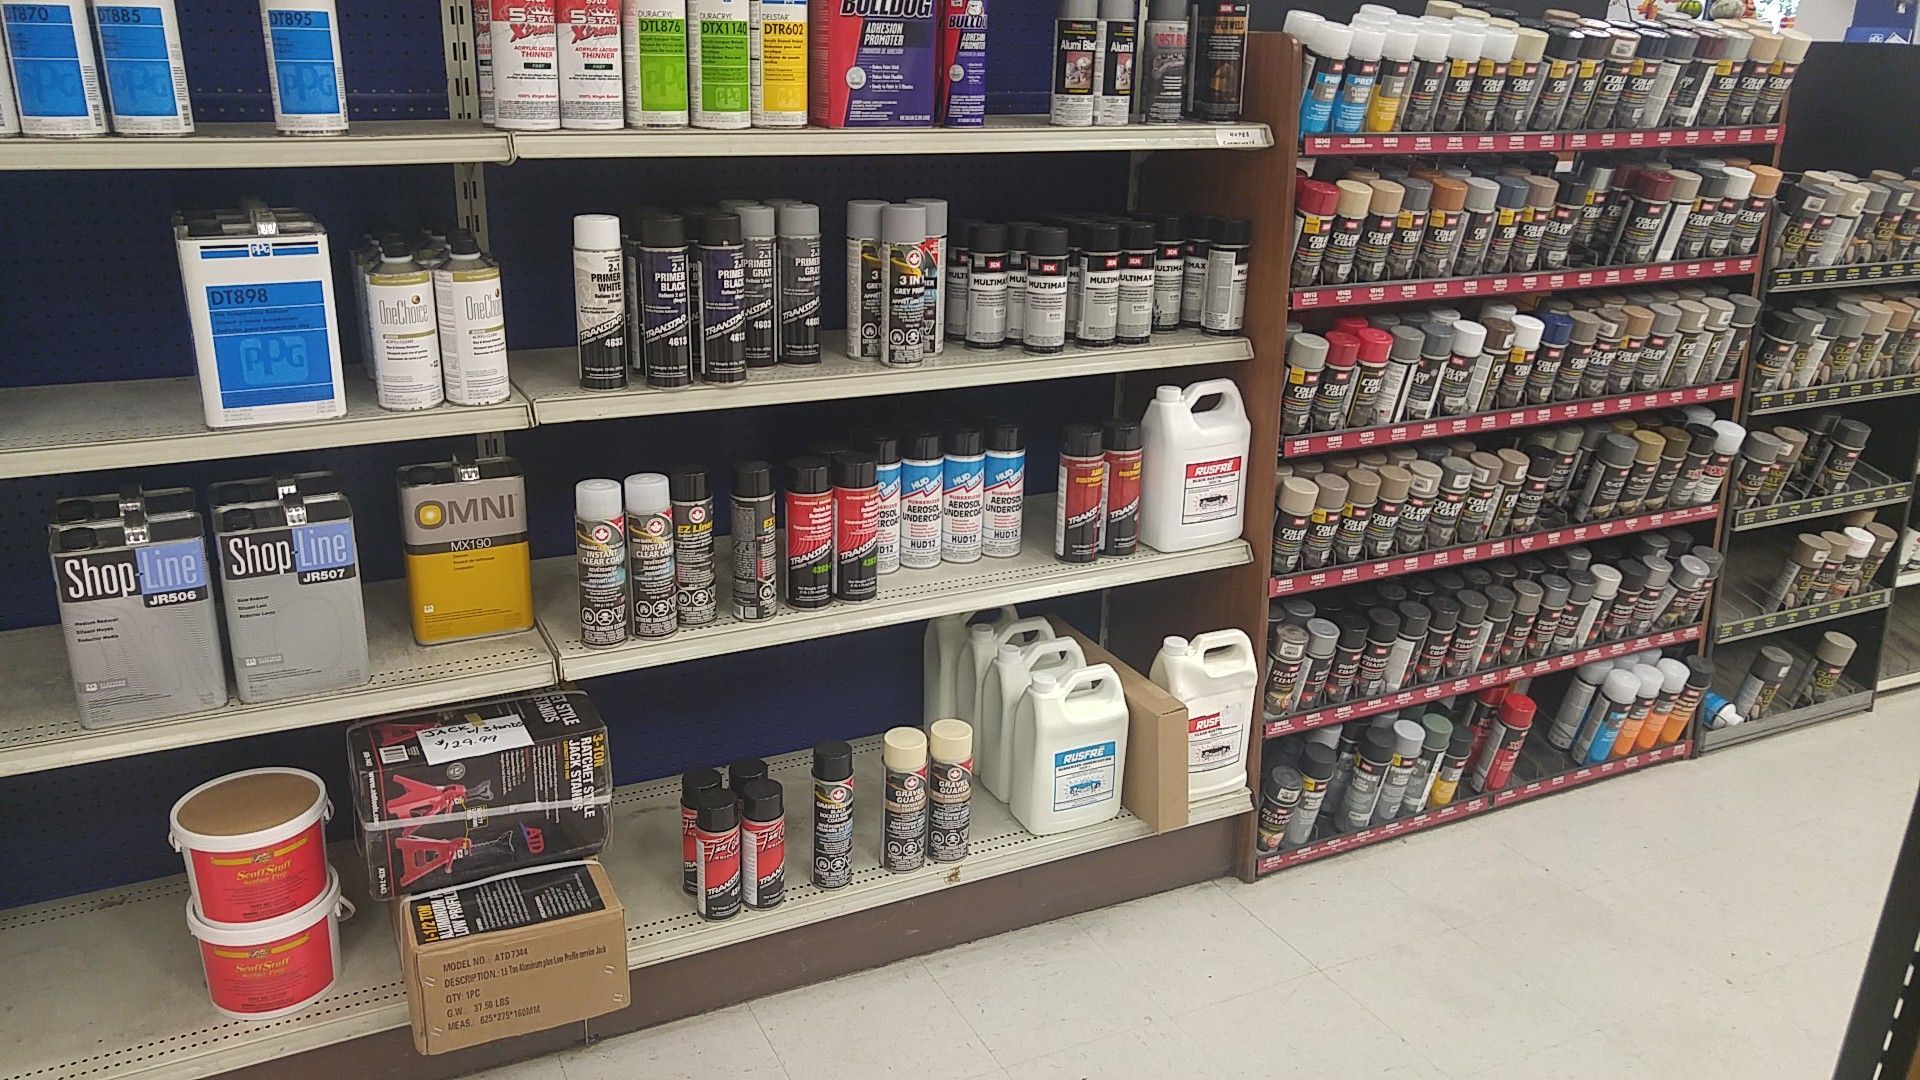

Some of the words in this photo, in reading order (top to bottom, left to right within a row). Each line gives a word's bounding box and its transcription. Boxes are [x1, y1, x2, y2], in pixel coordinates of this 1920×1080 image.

[840, 0, 932, 17] BULLDOG
[98, 8, 141, 23] DT885
[269, 13, 312, 27] DT895
[509, 8, 526, 22] 5
[570, 10, 586, 24] 5
[640, 21, 680, 32] DTL876
[702, 23, 747, 35] DTX1140
[764, 24, 803, 35] DTR602
[866, 23, 904, 34] ADHESION
[864, 34, 904, 45] PROMOTER
[1060, 39, 1081, 50] Alumi
[1110, 41, 1130, 52] Alumi
[1635, 216, 1660, 224] COLOR
[1333, 233, 1360, 241] COLOR
[1369, 238, 1390, 246] COAT
[1334, 239, 1357, 247] COAT
[251, 243, 271, 255] PPG
[744, 258, 772, 269] PRIMER
[795, 257, 821, 267] PRIMER
[654, 271, 686, 282] PRIMER
[718, 269, 744, 280] PRIMER
[752, 267, 772, 278] GRAY
[804, 267, 821, 276] GRAY
[591, 273, 621, 284] PRIMER
[899, 275, 907, 285] 3
[908, 274, 920, 285] IN
[1118, 273, 1154, 283] ULTIMAX
[598, 282, 621, 292] WHITE
[660, 281, 687, 292] BLACK
[723, 279, 745, 289] BLACK
[1028, 281, 1066, 290] MULTIMAX
[894, 287, 910, 295] GREY
[211, 289, 268, 305] DT898
[379, 300, 428, 325] OneChoice
[782, 296, 821, 321] TRANSTAR
[580, 314, 623, 340] TRANSTAR
[645, 314, 687, 339] TRANSTAR
[705, 310, 746, 335] TRANSTAR
[753, 320, 772, 329] 4603
[668, 336, 688, 347] 4613
[245, 338, 305, 375] PPG
[953, 472, 971, 485] HUD
[995, 469, 1014, 482] HUD
[911, 477, 930, 491] HUD
[948, 500, 981, 508] AEROSOL
[991, 496, 1022, 504] AEROSOL
[1434, 501, 1463, 510] COLOR
[415, 494, 515, 530] OMNI
[907, 504, 940, 513] AEROSOL
[1434, 508, 1460, 517] COAT
[1372, 513, 1399, 522] COLOR
[678, 525, 690, 533] EZ
[1372, 520, 1395, 528] COAT
[994, 530, 1018, 538] HUD12
[1281, 528, 1307, 536] COLOR
[451, 538, 492, 552] MX190
[910, 540, 936, 548] HUD12
[951, 535, 977, 544] HUD12
[642, 542, 670, 551] INSTANT
[228, 537, 291, 576] Shop
[297, 529, 347, 567] Line
[587, 549, 617, 558] INSTANT
[636, 550, 659, 558] CLEAR
[64, 558, 135, 599] Shop
[141, 550, 197, 589] Line
[301, 568, 345, 583] JR507
[149, 590, 197, 606] JR506
[556, 704, 580, 726] STYLE
[423, 725, 468, 737] JACK
[435, 735, 498, 749] $129.99
[568, 740, 582, 768] JACK
[593, 734, 605, 767] 3-TON
[581, 736, 594, 784] RATCHET
[939, 779, 968, 787] GRAVEL
[236, 867, 266, 881] Scuff
[266, 859, 292, 875] Stuff
[417, 904, 434, 921] TON
[430, 899, 455, 939] ALUMINUM
[421, 920, 440, 942] 1-1/2
[452, 919, 470, 937] LOW
[236, 963, 264, 974] Scuff
[264, 955, 291, 968] Stuff
[443, 960, 471, 972] MODEL
[494, 948, 529, 962] ATD7344
[509, 965, 518, 974] Ton
[519, 960, 542, 972] Aluminum
[543, 956, 553, 968] plus
[554, 955, 564, 965] Low
[564, 951, 579, 962] Profile
[579, 949, 595, 958] service
[595, 945, 607, 955] Jack
[446, 994, 464, 1004] QTY:
[466, 988, 480, 1000] 1PC
[473, 1001, 493, 1013] 37.50
[495, 996, 510, 1007] LBS
[480, 1004, 541, 1025] 625275160MM
